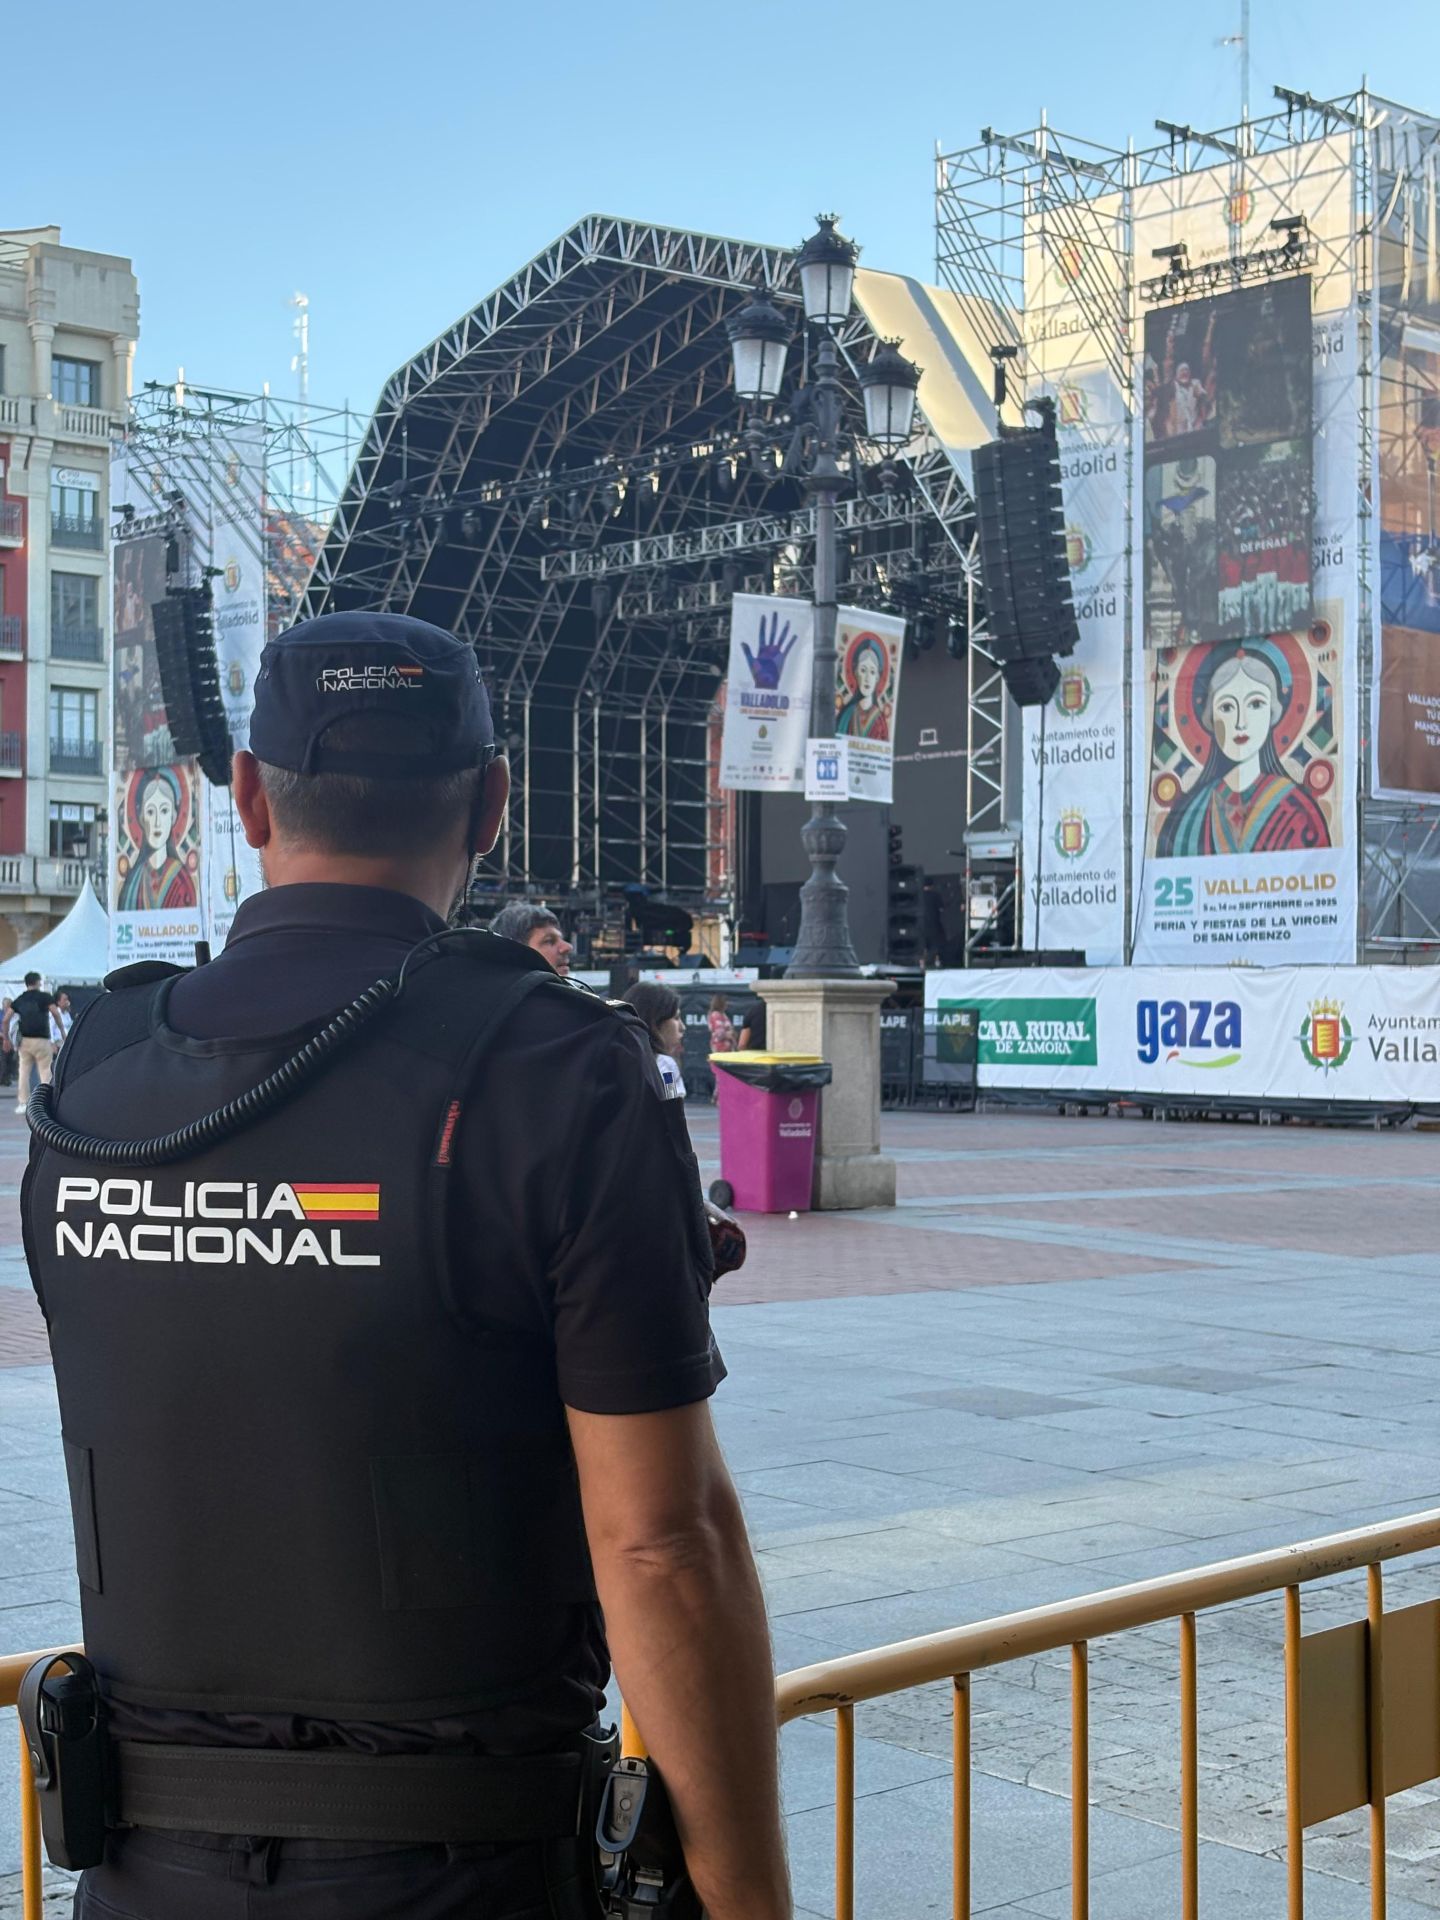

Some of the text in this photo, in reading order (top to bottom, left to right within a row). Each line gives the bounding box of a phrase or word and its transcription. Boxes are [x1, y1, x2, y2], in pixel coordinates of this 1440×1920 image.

[1061, 452, 1117, 479] adolid
[323, 677, 423, 692] NACIONAL
[1102, 724, 1115, 737] de
[1031, 740, 1116, 766] Valladolid
[1103, 867, 1116, 880] de
[1154, 877, 1194, 907] 25
[1204, 873, 1337, 896] VALLADOLID
[1031, 883, 1117, 907] Valladolid
[1219, 903, 1227, 911] 14
[1238, 900, 1303, 911] SEPTIEMBRE
[1315, 897, 1338, 907] 2025
[138, 923, 199, 937] VALLADOLID
[1154, 914, 1338, 931] FERIA Y FIESTAS DE LA VIRGEN
[117, 924, 133, 944] 25
[1193, 929, 1291, 943] DE SAN LORENZO
[923, 1012, 970, 1027] BLAPE
[977, 1020, 1090, 1041] CAJA RURAL
[1137, 999, 1242, 1064] gaza
[995, 1041, 1073, 1055] DE ZAMORA
[1368, 1036, 1437, 1062] Valla
[56, 1220, 381, 1266] NACIONAL
